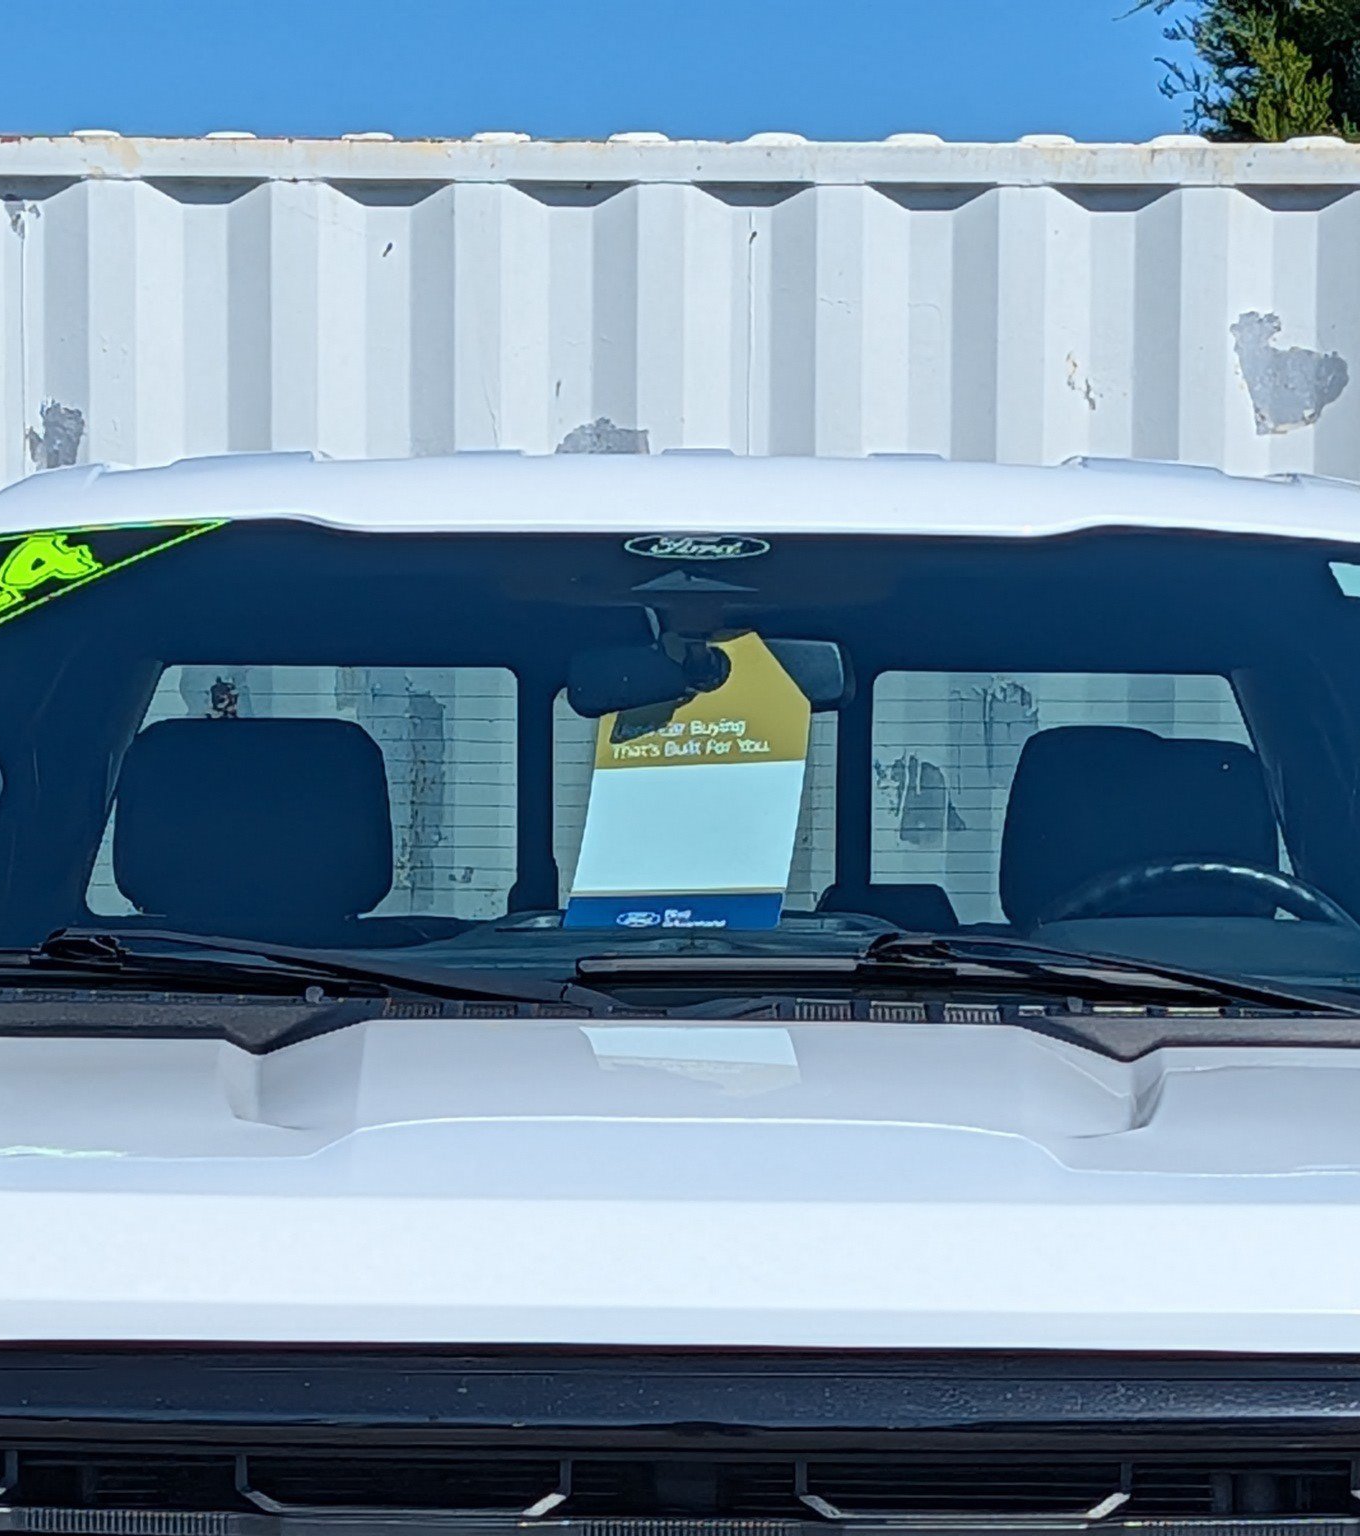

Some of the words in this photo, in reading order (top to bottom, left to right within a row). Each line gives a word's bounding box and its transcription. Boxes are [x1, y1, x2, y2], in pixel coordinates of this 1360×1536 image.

[650, 535, 743, 555] Ford
[690, 719, 746, 736] Buying
[612, 742, 660, 760] That's
[664, 740, 701, 757] Built
